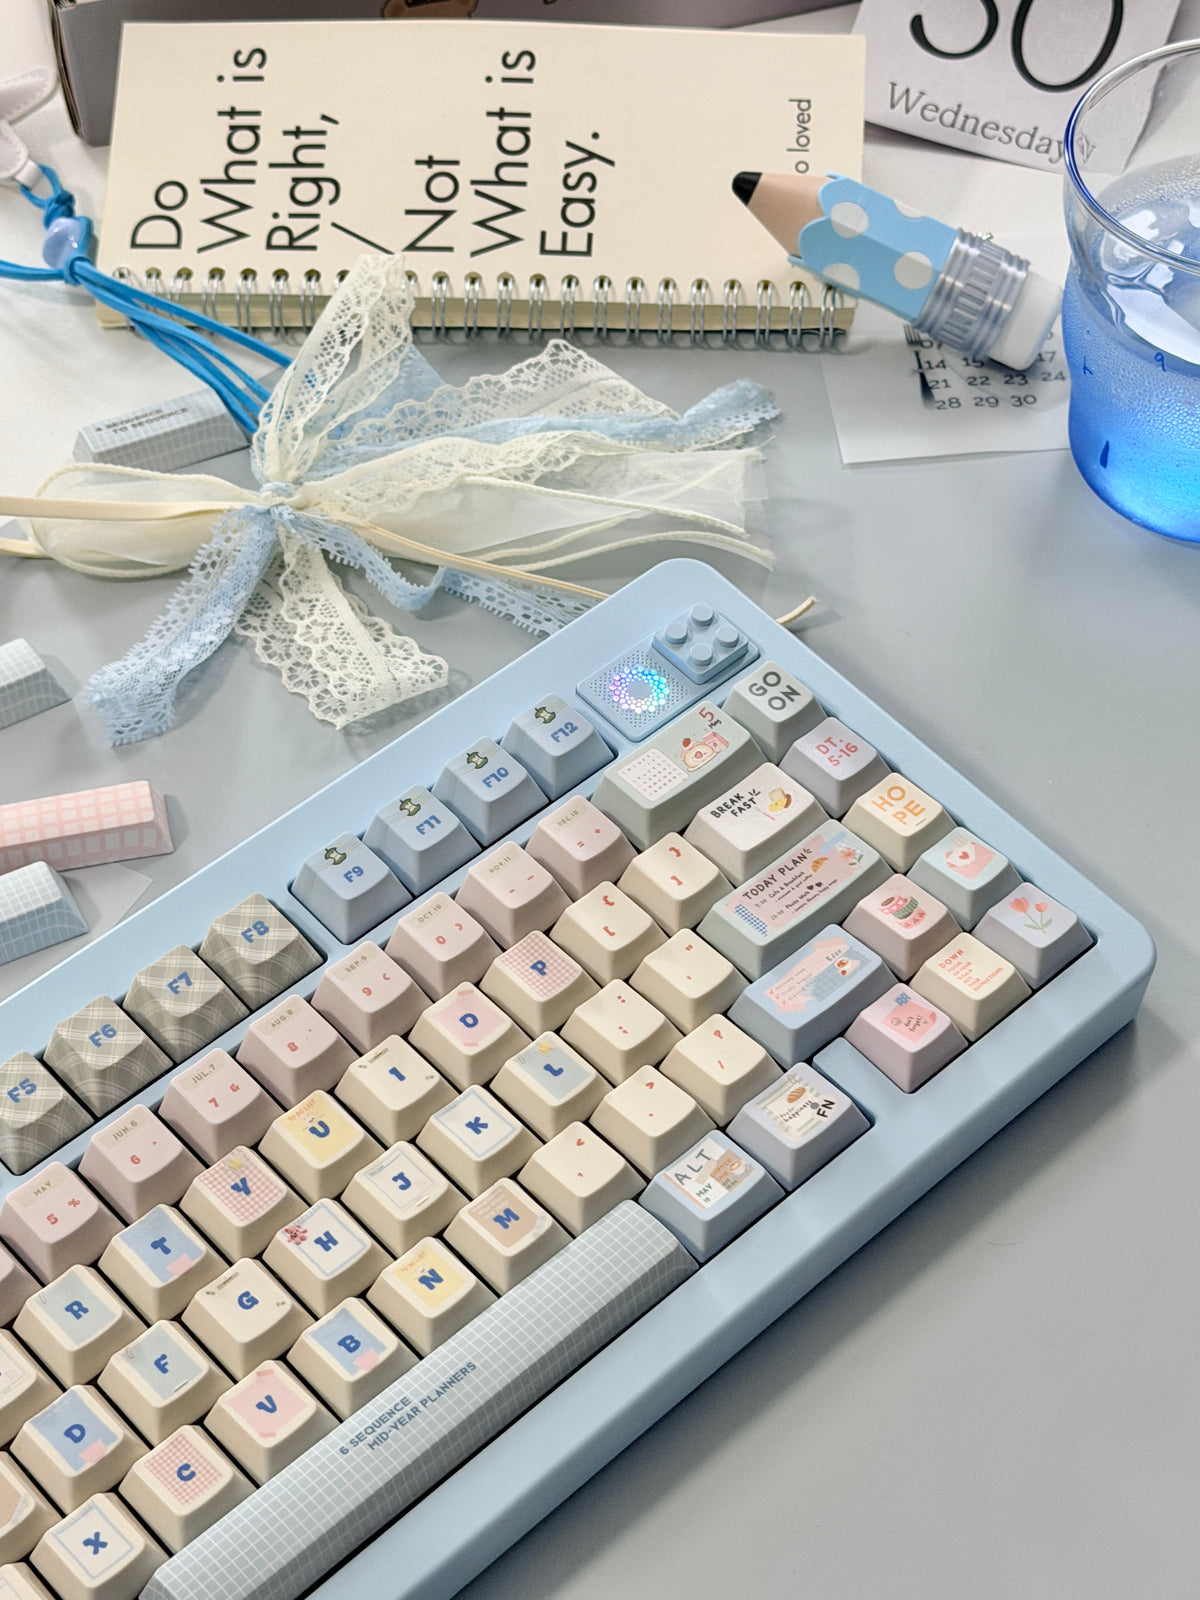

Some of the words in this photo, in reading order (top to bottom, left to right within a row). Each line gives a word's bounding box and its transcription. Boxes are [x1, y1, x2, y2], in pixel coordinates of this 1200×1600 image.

[217, 47, 267, 83] is
[485, 49, 536, 84] is
[786, 98, 811, 152] loved
[888, 82, 1066, 164] Wednesday
[197, 106, 263, 253] What
[266, 113, 340, 251] Right,
[470, 107, 533, 257] What
[403, 155, 462, 253] Not
[540, 130, 615, 257] Easy.
[130, 180, 189, 250] Do
[925, 359, 947, 371] 14
[962, 357, 984, 369] 15
[929, 379, 951, 390] 21
[967, 375, 990, 387] 22
[1004, 374, 1029, 386] 23
[1041, 371, 1067, 383] 24
[935, 397, 962, 410] 28
[974, 395, 999, 408] 29
[1010, 394, 1037, 408] 30
[749, 671, 781, 697] GO
[768, 684, 802, 711] ON
[699, 707, 714, 722] 5
[550, 721, 578, 743] F12
[814, 736, 844, 756] DT.
[827, 742, 859, 767] 5-16
[482, 767, 509, 788] F10
[710, 792, 745, 819] BREAK
[730, 798, 757, 818] FAST
[871, 785, 906, 812] HO
[892, 799, 927, 826] PE
[415, 814, 442, 835] F11
[343, 865, 365, 883] F9
[742, 874, 778, 900] TODAY
[777, 852, 809, 875] PLAN
[241, 920, 270, 943] F8
[530, 959, 547, 977] P
[939, 948, 964, 971] DOWN
[167, 971, 193, 995] F7
[362, 987, 372, 997] 9
[88, 1023, 118, 1048] F6
[287, 1041, 299, 1052] 8
[191, 1063, 217, 1084] JUL.7
[543, 1063, 564, 1077] L
[7, 1078, 37, 1103] F5
[208, 1097, 219, 1108] 7
[817, 1099, 836, 1118] FN
[112, 1120, 138, 1140] JUN.6
[309, 1120, 331, 1138] U
[465, 1116, 489, 1135] K
[130, 1155, 141, 1165] 6
[674, 1148, 712, 1186] ALT
[32, 1180, 52, 1197] MAY
[230, 1177, 252, 1196] Y
[392, 1172, 412, 1190] J
[46, 1213, 59, 1225] 5
[493, 1208, 520, 1230] M
[150, 1236, 172, 1255] T
[314, 1231, 339, 1252] H
[418, 1269, 444, 1291] N
[65, 1300, 89, 1320] R
[237, 1290, 259, 1310] G
[337, 1334, 361, 1353] B
[154, 1354, 169, 1374] F
[256, 1395, 278, 1414] V
[367, 1406, 422, 1451] MID-YEAR
[421, 1361, 477, 1410] PLANNERS
[64, 1423, 86, 1444] D
[340, 1446, 349, 1455] 6
[349, 1396, 411, 1448] SEQUENCE
[177, 1463, 196, 1482] C
[82, 1531, 108, 1555] X
